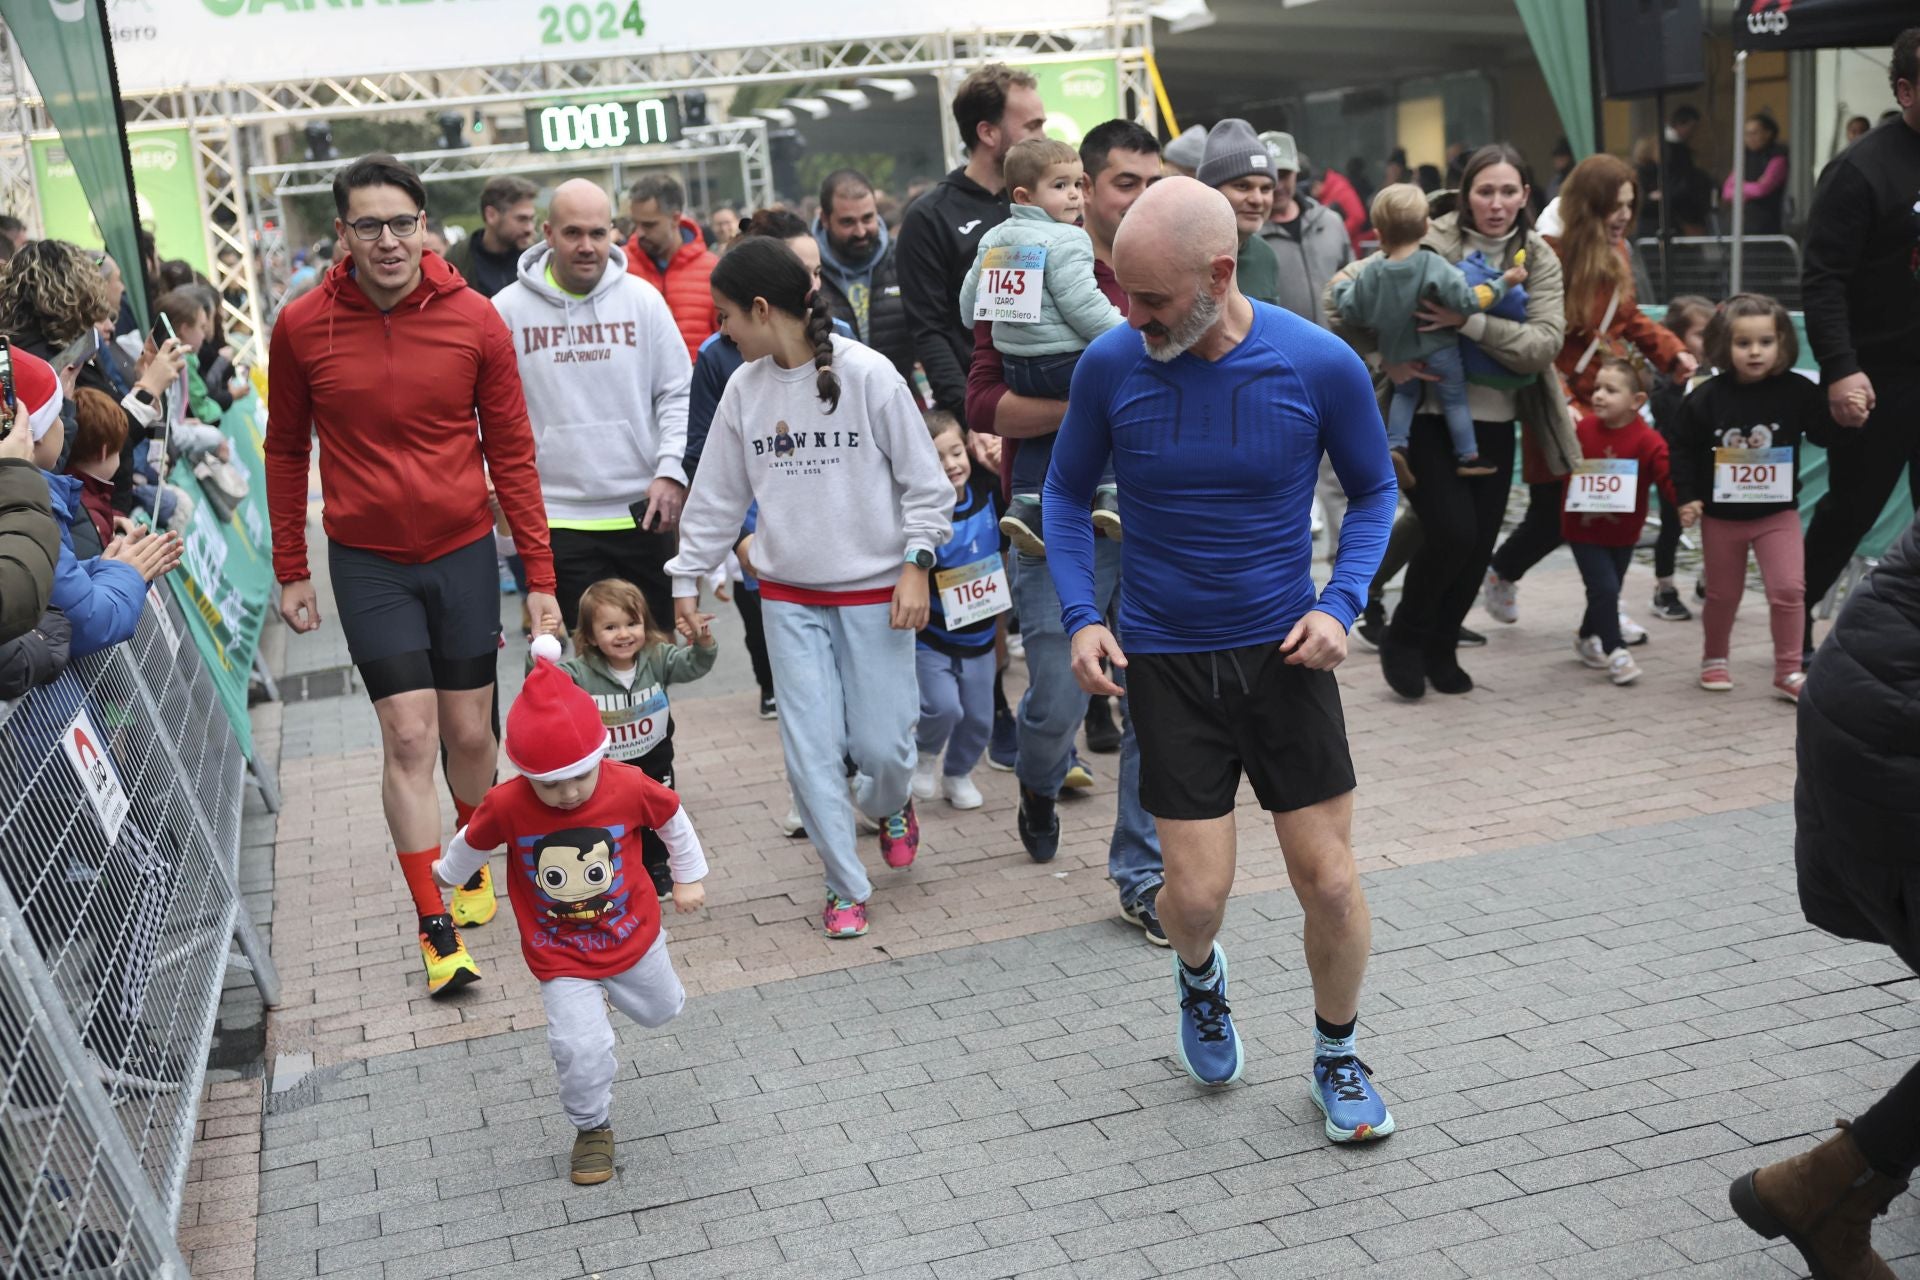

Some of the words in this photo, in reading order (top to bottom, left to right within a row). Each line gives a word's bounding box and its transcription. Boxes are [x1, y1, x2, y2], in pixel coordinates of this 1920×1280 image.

[538, 0, 645, 44] 2024
[988, 270, 1025, 295] 1143
[994, 297, 1015, 305] IZARO
[995, 309, 1032, 319] PDMSiero
[752, 431, 859, 456] BRWNIE
[1579, 475, 1621, 492] 1150
[1730, 465, 1776, 483] 1201
[953, 575, 997, 605] 1164
[606, 718, 652, 743] 1110
[609, 734, 654, 751] EMMANUEL
